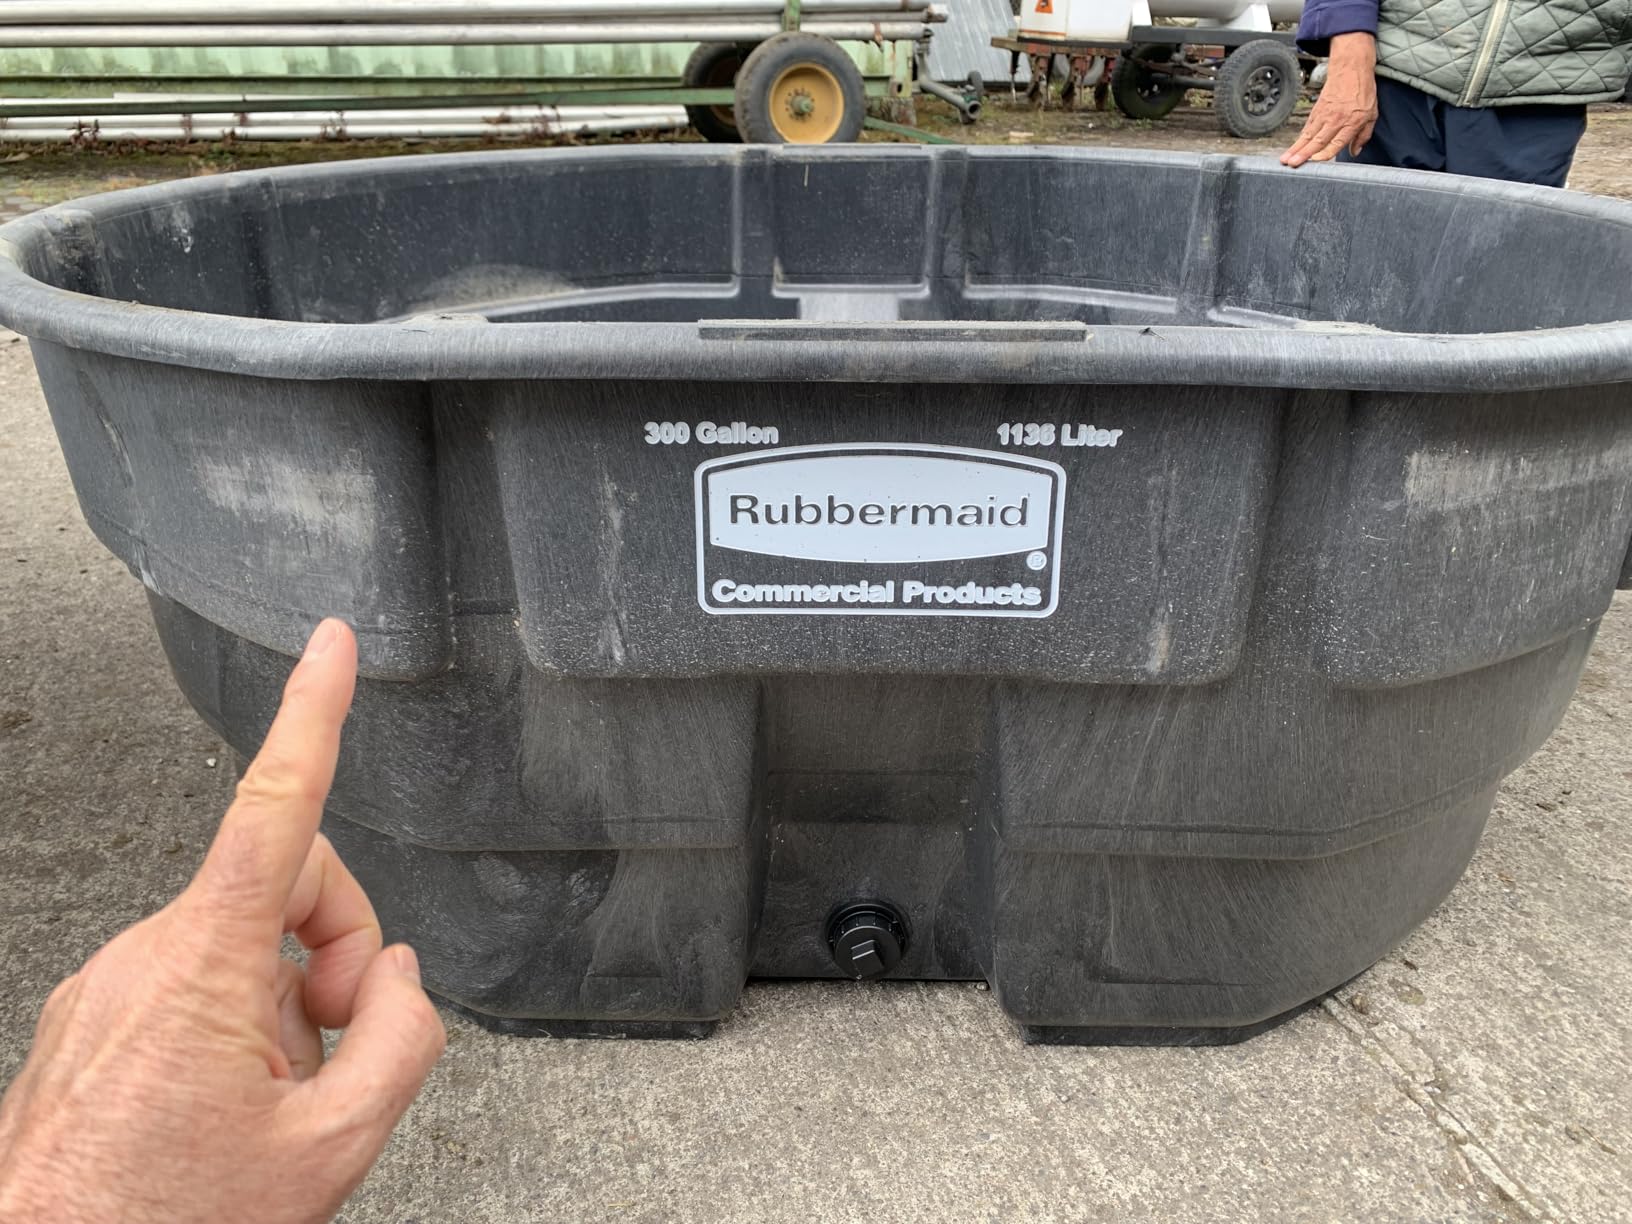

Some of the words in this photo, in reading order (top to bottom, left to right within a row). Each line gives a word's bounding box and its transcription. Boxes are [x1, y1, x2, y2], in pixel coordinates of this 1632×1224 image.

[644, 421, 690, 445] 300
[695, 422, 779, 445] Gallon
[997, 423, 1056, 446] 1136
[1060, 424, 1123, 447] Liter
[730, 494, 1028, 526] Rubbermaid
[712, 579, 895, 604] Commercial
[903, 580, 1042, 606] Products
